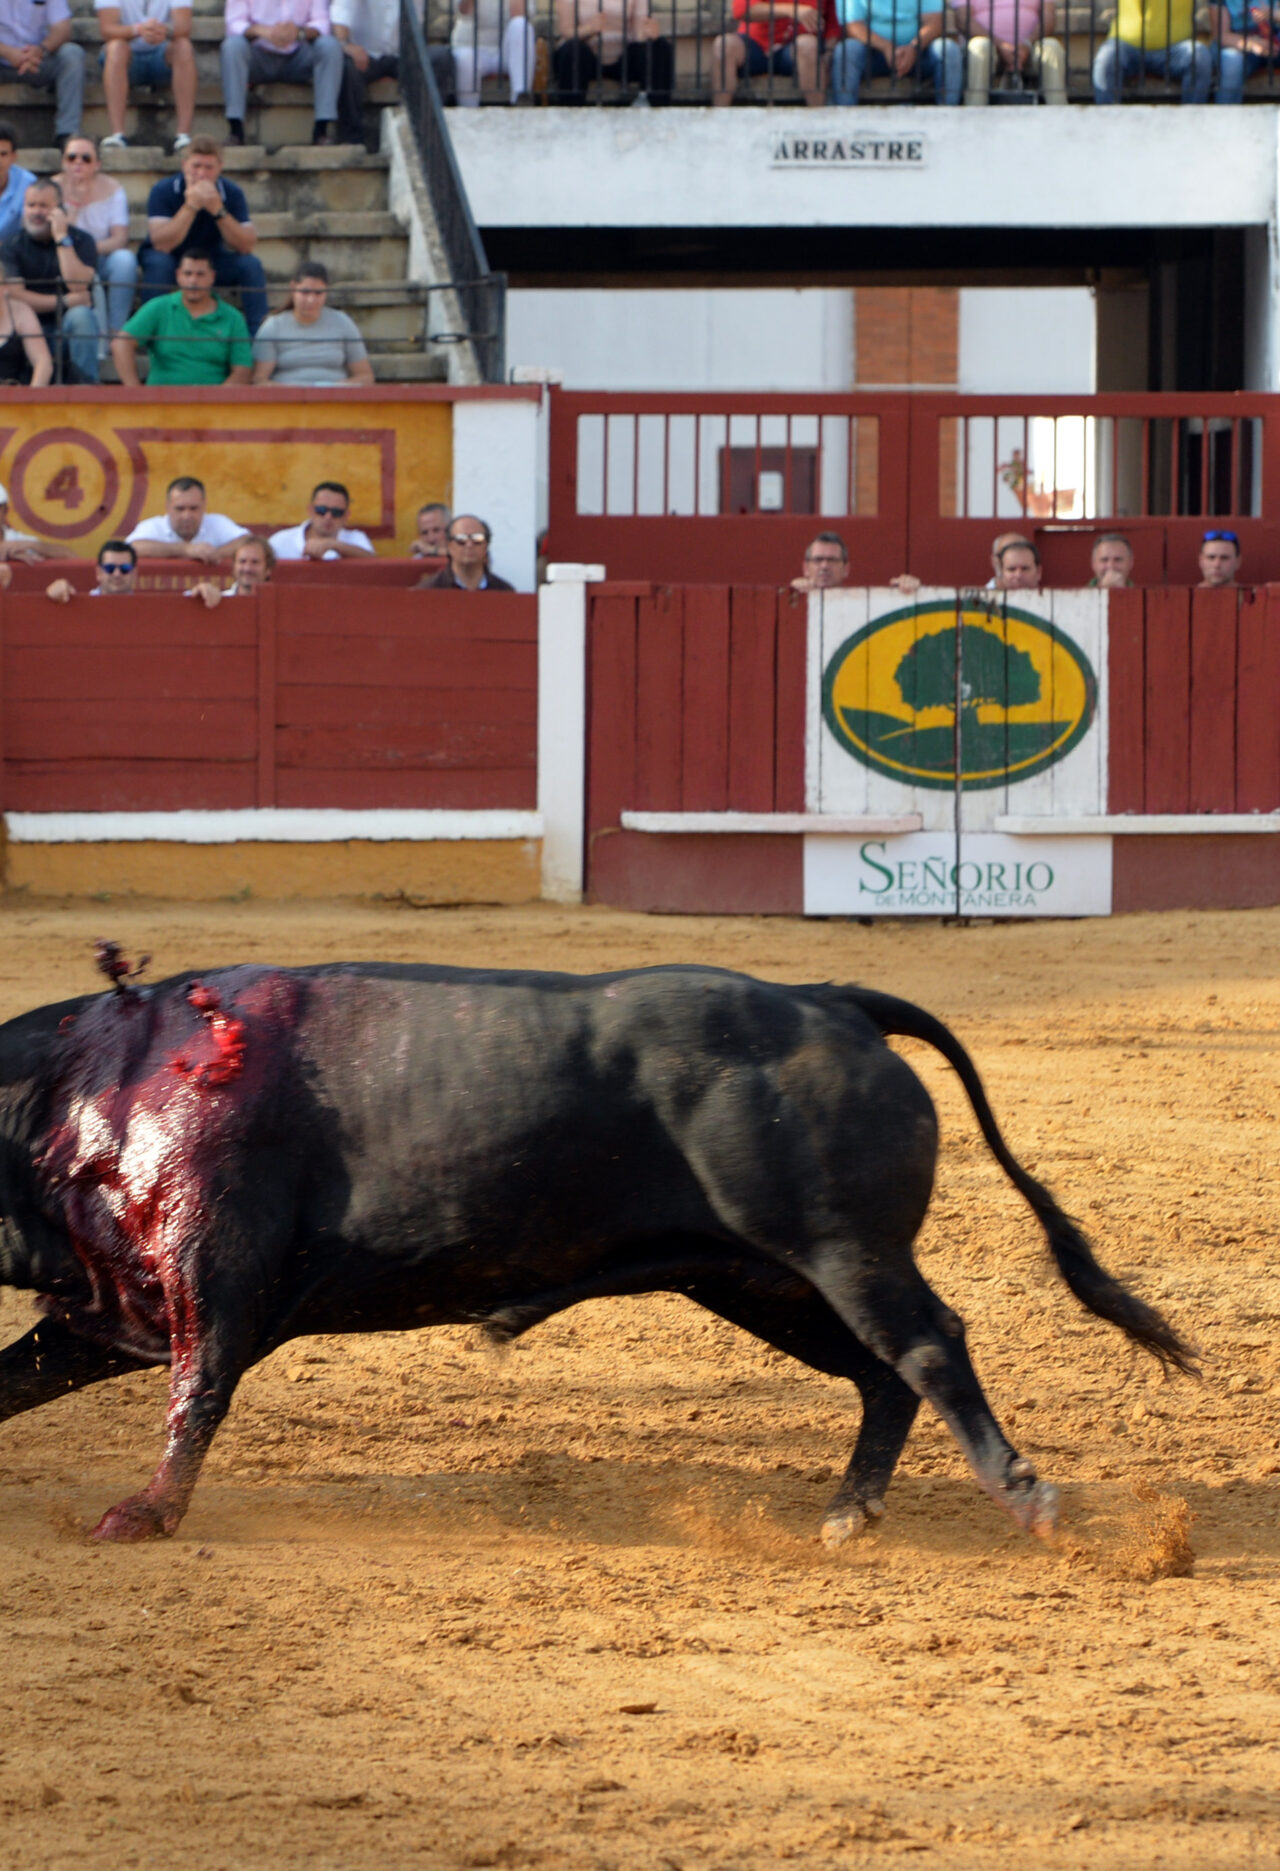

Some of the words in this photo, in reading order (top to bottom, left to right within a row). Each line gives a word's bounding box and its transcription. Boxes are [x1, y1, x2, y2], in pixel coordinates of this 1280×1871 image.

[773, 140, 923, 160] ARRASTRE
[45, 465, 85, 509] 4
[875, 894, 894, 906] DE
[898, 892, 1038, 907] MONTANERA
